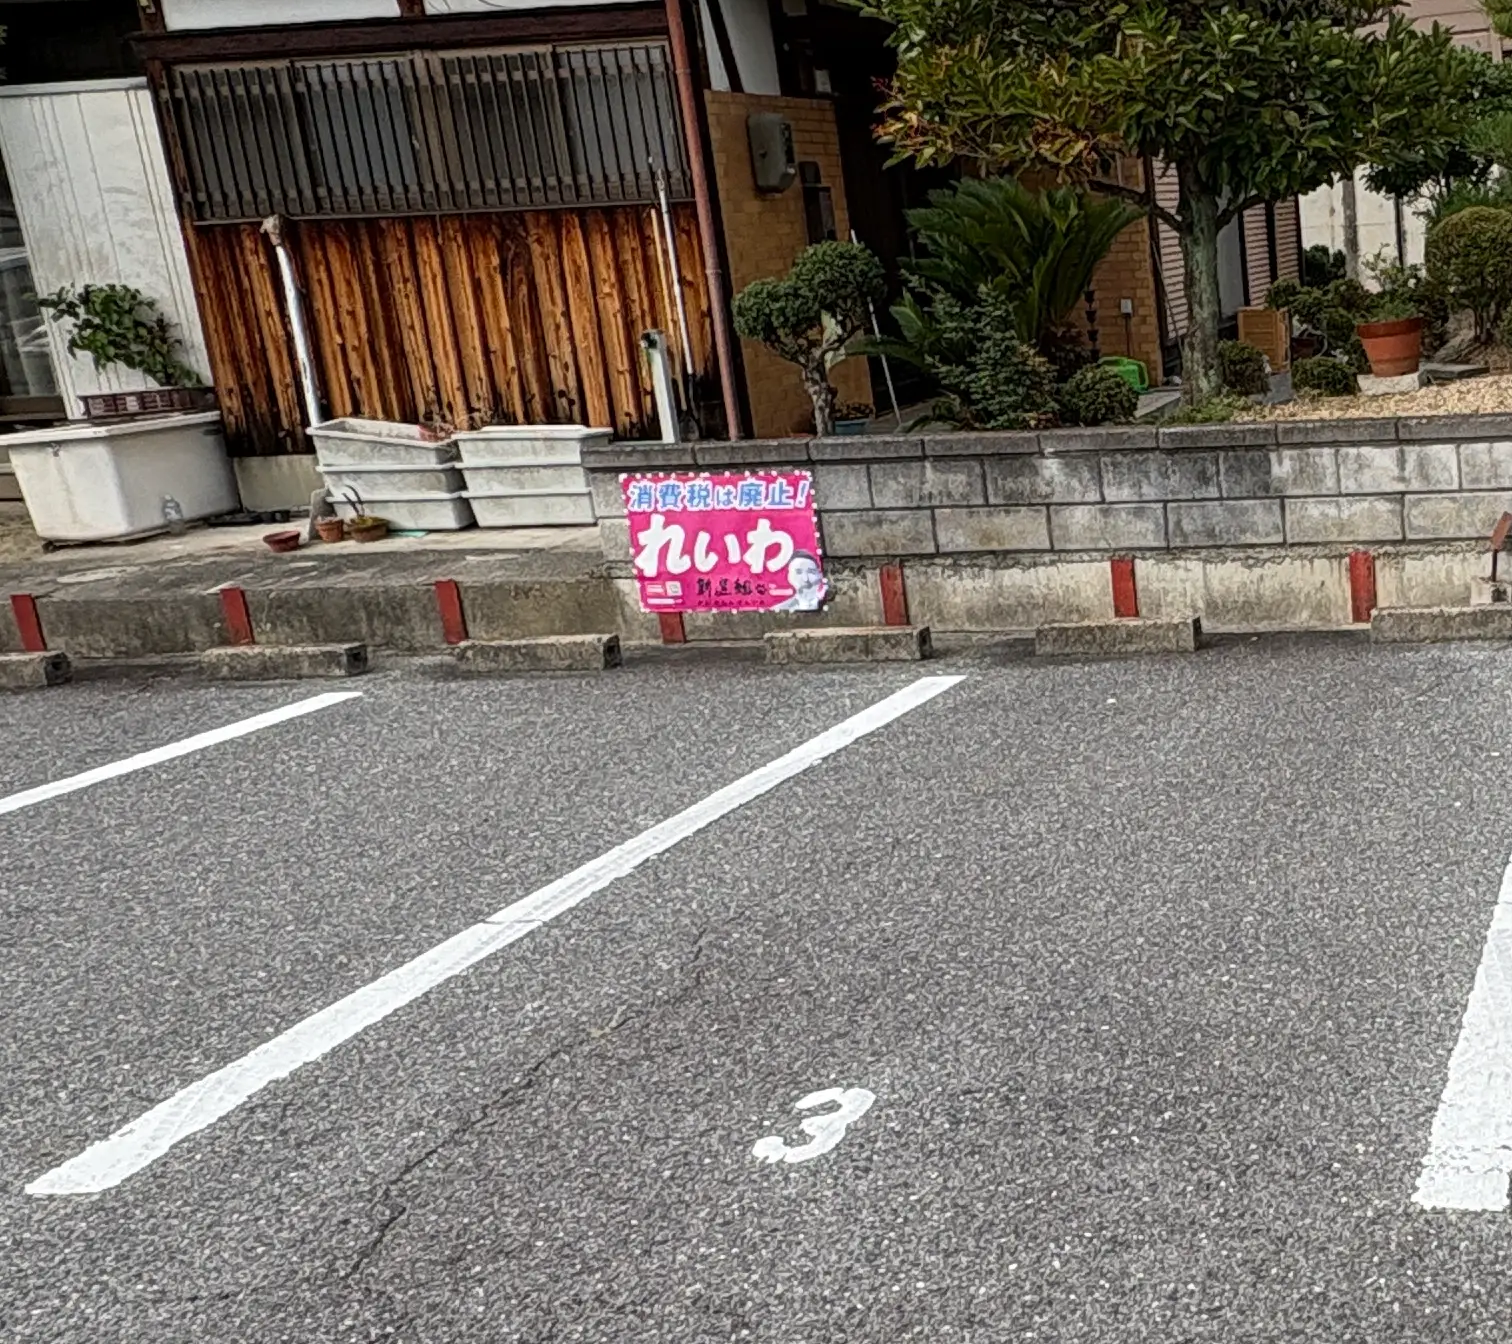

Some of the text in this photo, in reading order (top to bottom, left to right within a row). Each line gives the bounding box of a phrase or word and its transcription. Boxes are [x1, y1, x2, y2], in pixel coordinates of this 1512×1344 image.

[634, 513, 795, 578] れいわ
[752, 1087, 877, 1164] 3
